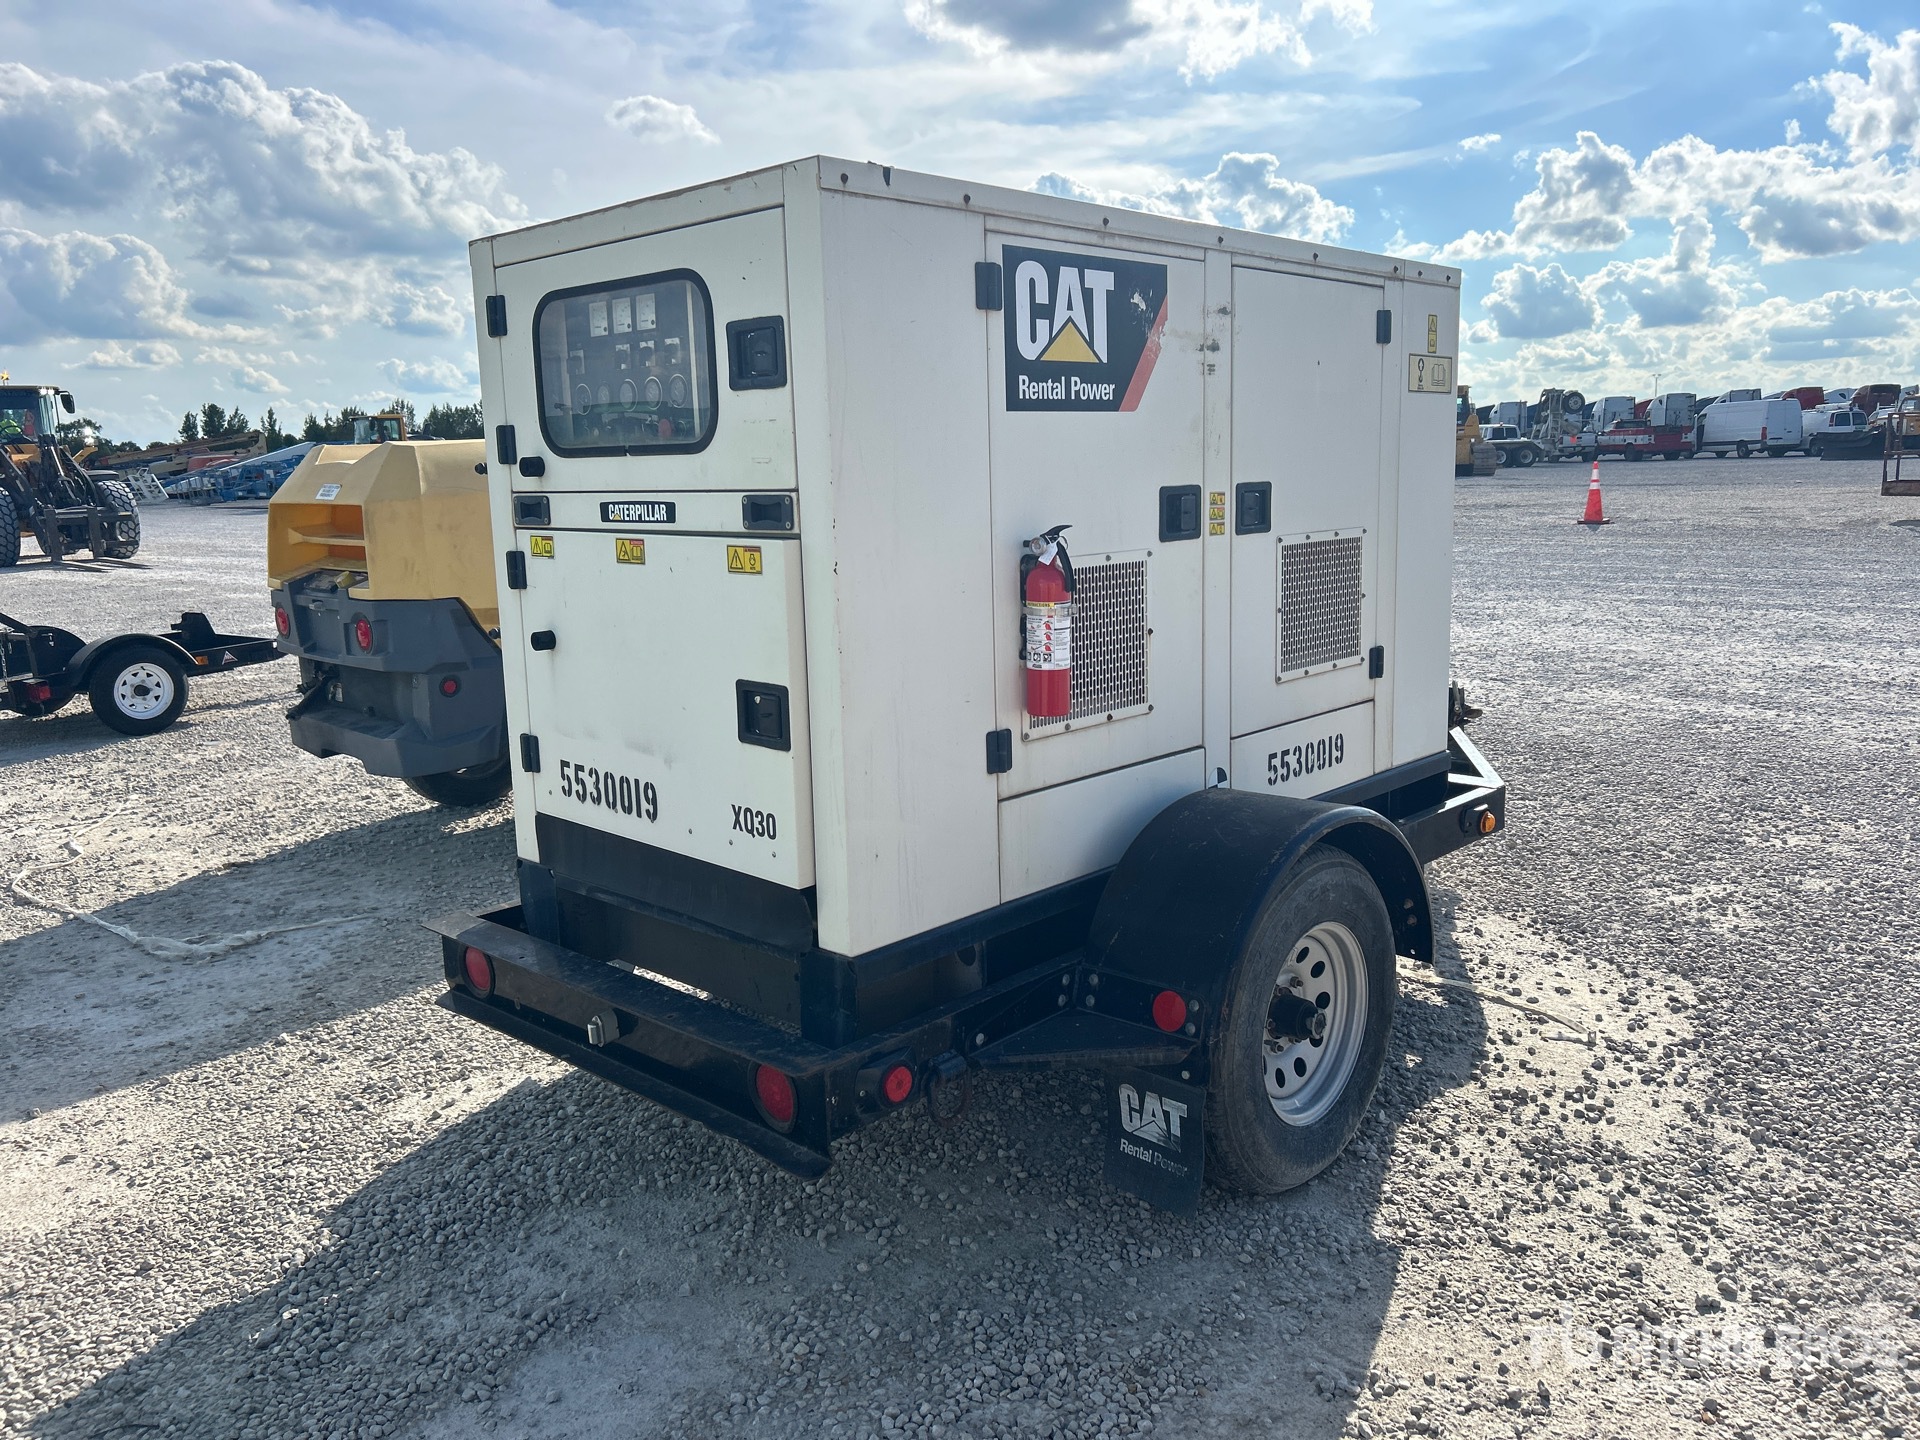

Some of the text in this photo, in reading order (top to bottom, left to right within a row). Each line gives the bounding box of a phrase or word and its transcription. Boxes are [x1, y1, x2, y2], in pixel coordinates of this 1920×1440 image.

[1015, 260, 1115, 364] CAT
[1018, 374, 1116, 401] Rental Power
[608, 502, 667, 521] CATERPILLAR
[1267, 733, 1345, 787] 5530019
[560, 759, 659, 822] 5530019
[731, 804, 777, 840] XQ30
[1118, 1083, 1188, 1153] CAT
[1119, 1138, 1153, 1163] Rental
